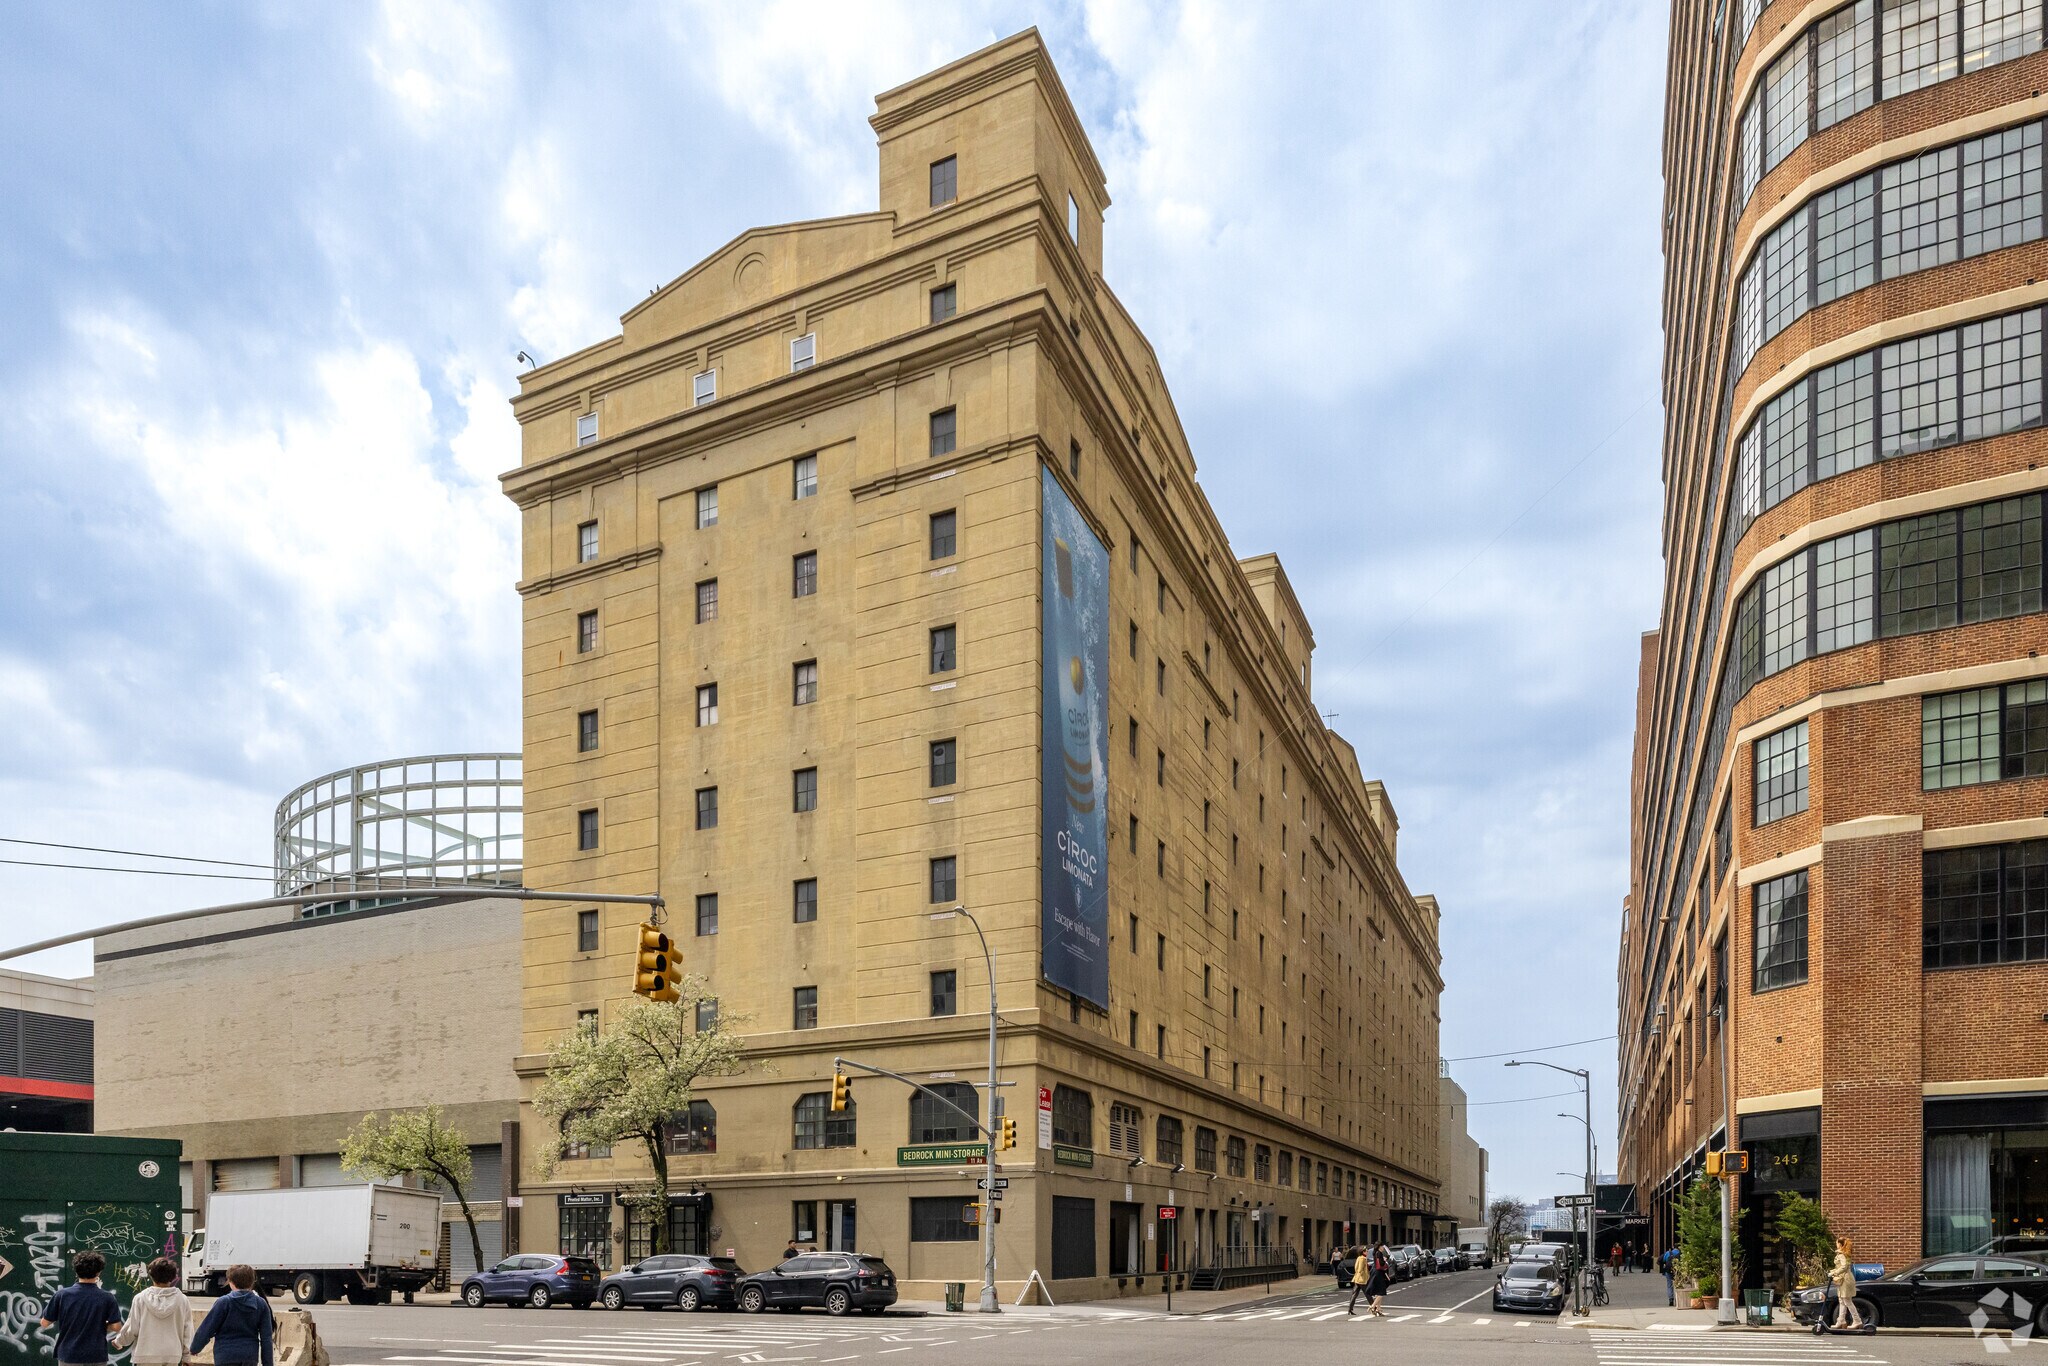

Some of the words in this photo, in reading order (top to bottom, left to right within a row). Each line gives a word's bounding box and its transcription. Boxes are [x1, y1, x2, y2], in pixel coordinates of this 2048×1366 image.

[1057, 829, 1097, 874] CÎROC
[1062, 856, 1094, 889] LIMONATA
[1054, 907, 1074, 932] Escape
[1073, 921, 1086, 938] with
[1085, 926, 1101, 947] Flavor
[1039, 1088, 1047, 1098] For
[1039, 1098, 1051, 1109] Lease
[903, 1150, 934, 1160] BEDROCK
[935, 1148, 985, 1159] MINI-STORAGE
[1773, 1153, 1798, 1165] 245
[1560, 1197, 1573, 1205] ONE
